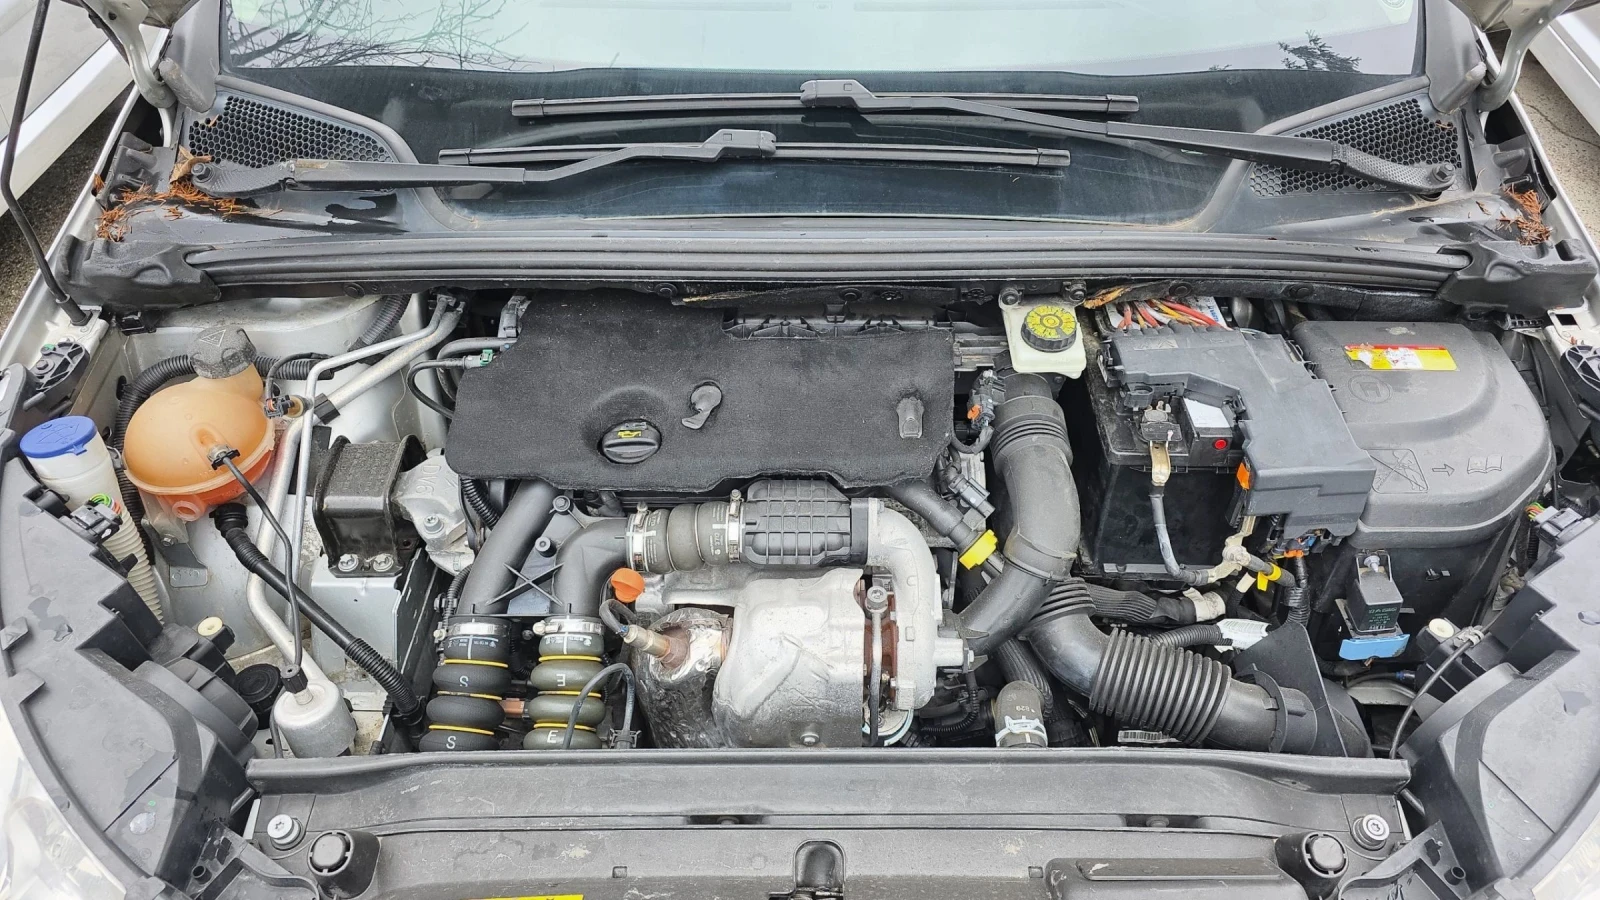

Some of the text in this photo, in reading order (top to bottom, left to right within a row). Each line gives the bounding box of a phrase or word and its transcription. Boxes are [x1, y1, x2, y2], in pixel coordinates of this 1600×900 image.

[416, 465, 441, 494] DV6
[459, 675, 469, 687] S
[556, 673, 566, 687] E
[446, 735, 457, 749] S
[547, 730, 558, 743] E
